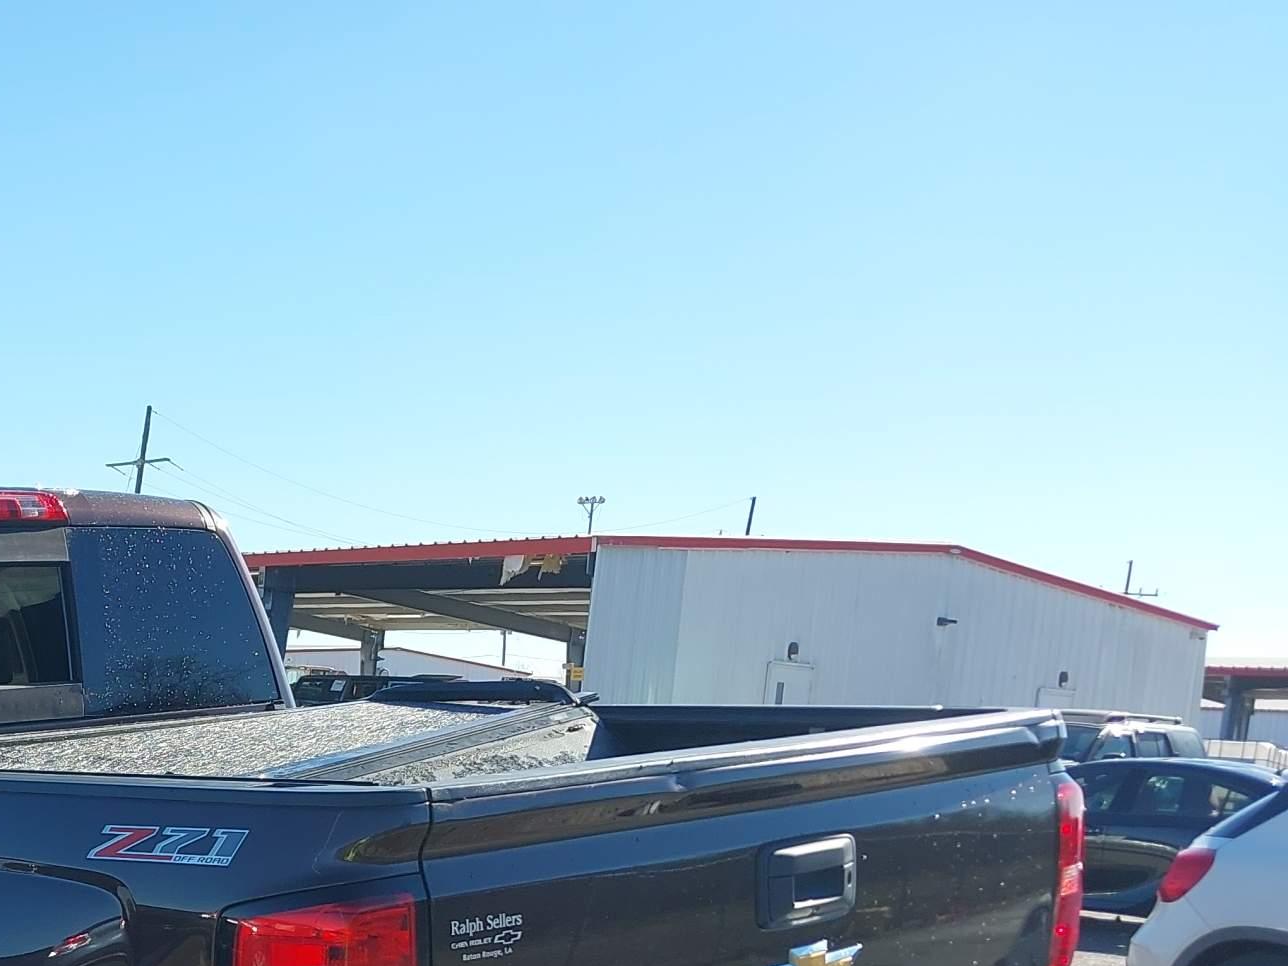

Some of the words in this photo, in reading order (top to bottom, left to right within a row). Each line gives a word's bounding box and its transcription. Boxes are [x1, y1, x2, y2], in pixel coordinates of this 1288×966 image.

[87, 824, 250, 867] Z71
[197, 857, 230, 865] ROAD
[451, 917, 484, 936] Ralph
[486, 913, 523, 930] Sellers
